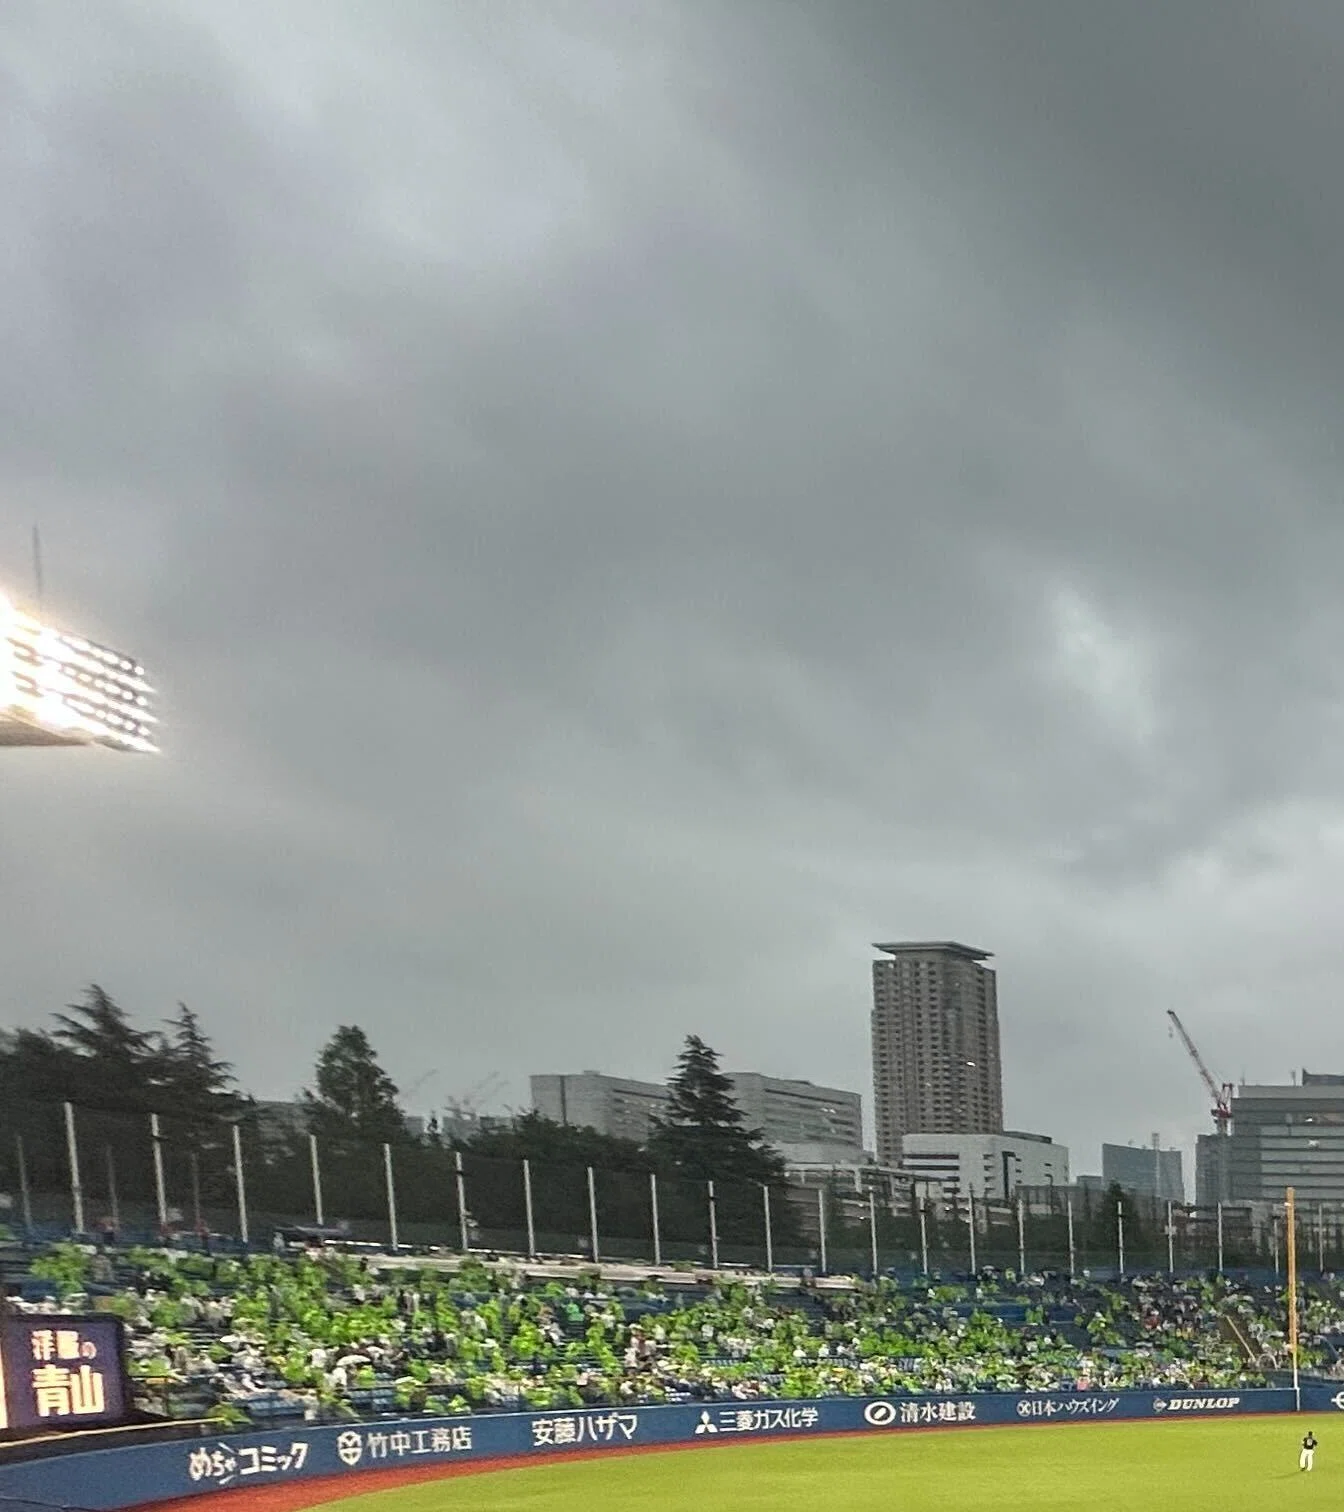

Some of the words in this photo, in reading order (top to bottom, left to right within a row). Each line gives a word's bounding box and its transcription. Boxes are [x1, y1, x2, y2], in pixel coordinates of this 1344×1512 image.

[31, 1364, 105, 1418] 青山
[1167, 1397, 1240, 1411] DUNLOP
[719, 1406, 820, 1433] 三菱ガス化学
[900, 1401, 977, 1423] 清水建設
[367, 1426, 472, 1459] 竹中工務店
[532, 1413, 639, 1447] 安藤ハザマ
[189, 1442, 309, 1482] めちゃコミック
